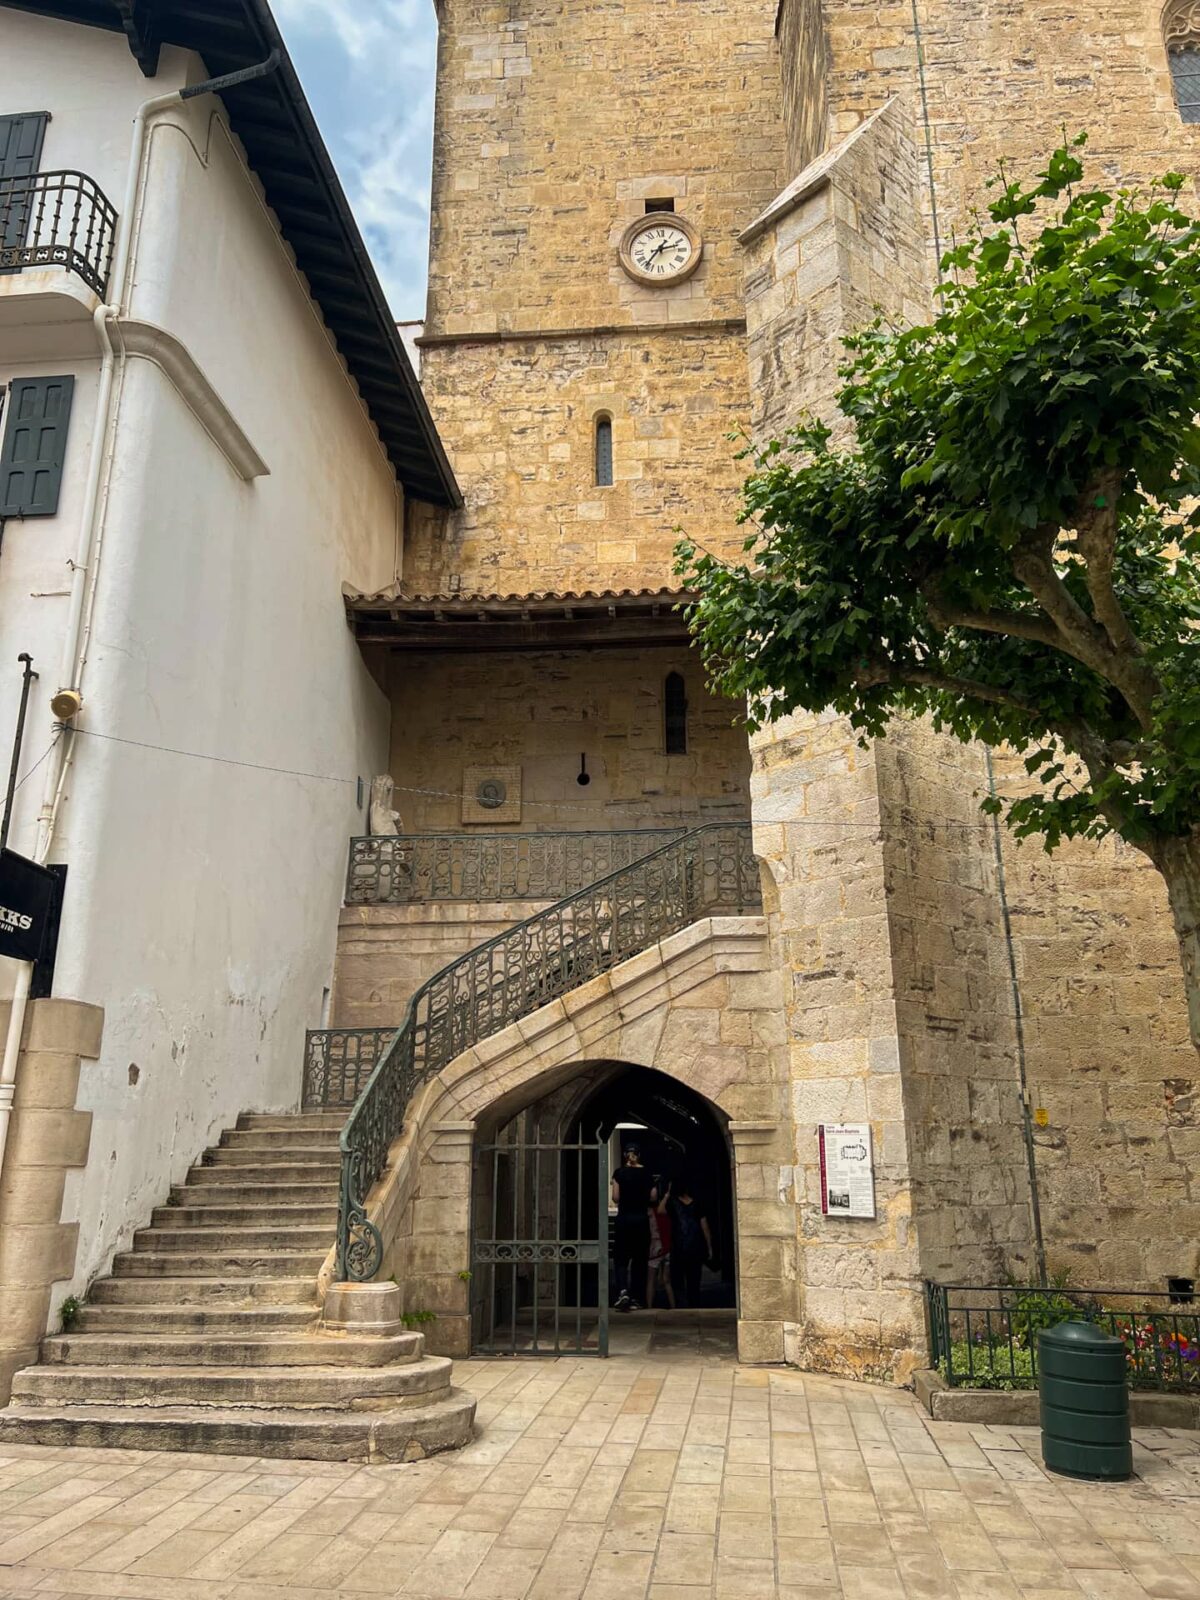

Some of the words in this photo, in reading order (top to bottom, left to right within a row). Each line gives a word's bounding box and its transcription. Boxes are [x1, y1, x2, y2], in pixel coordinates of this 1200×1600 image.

[645, 232, 655, 240] XI
[655, 229, 664, 237] XII
[668, 231, 674, 239] I
